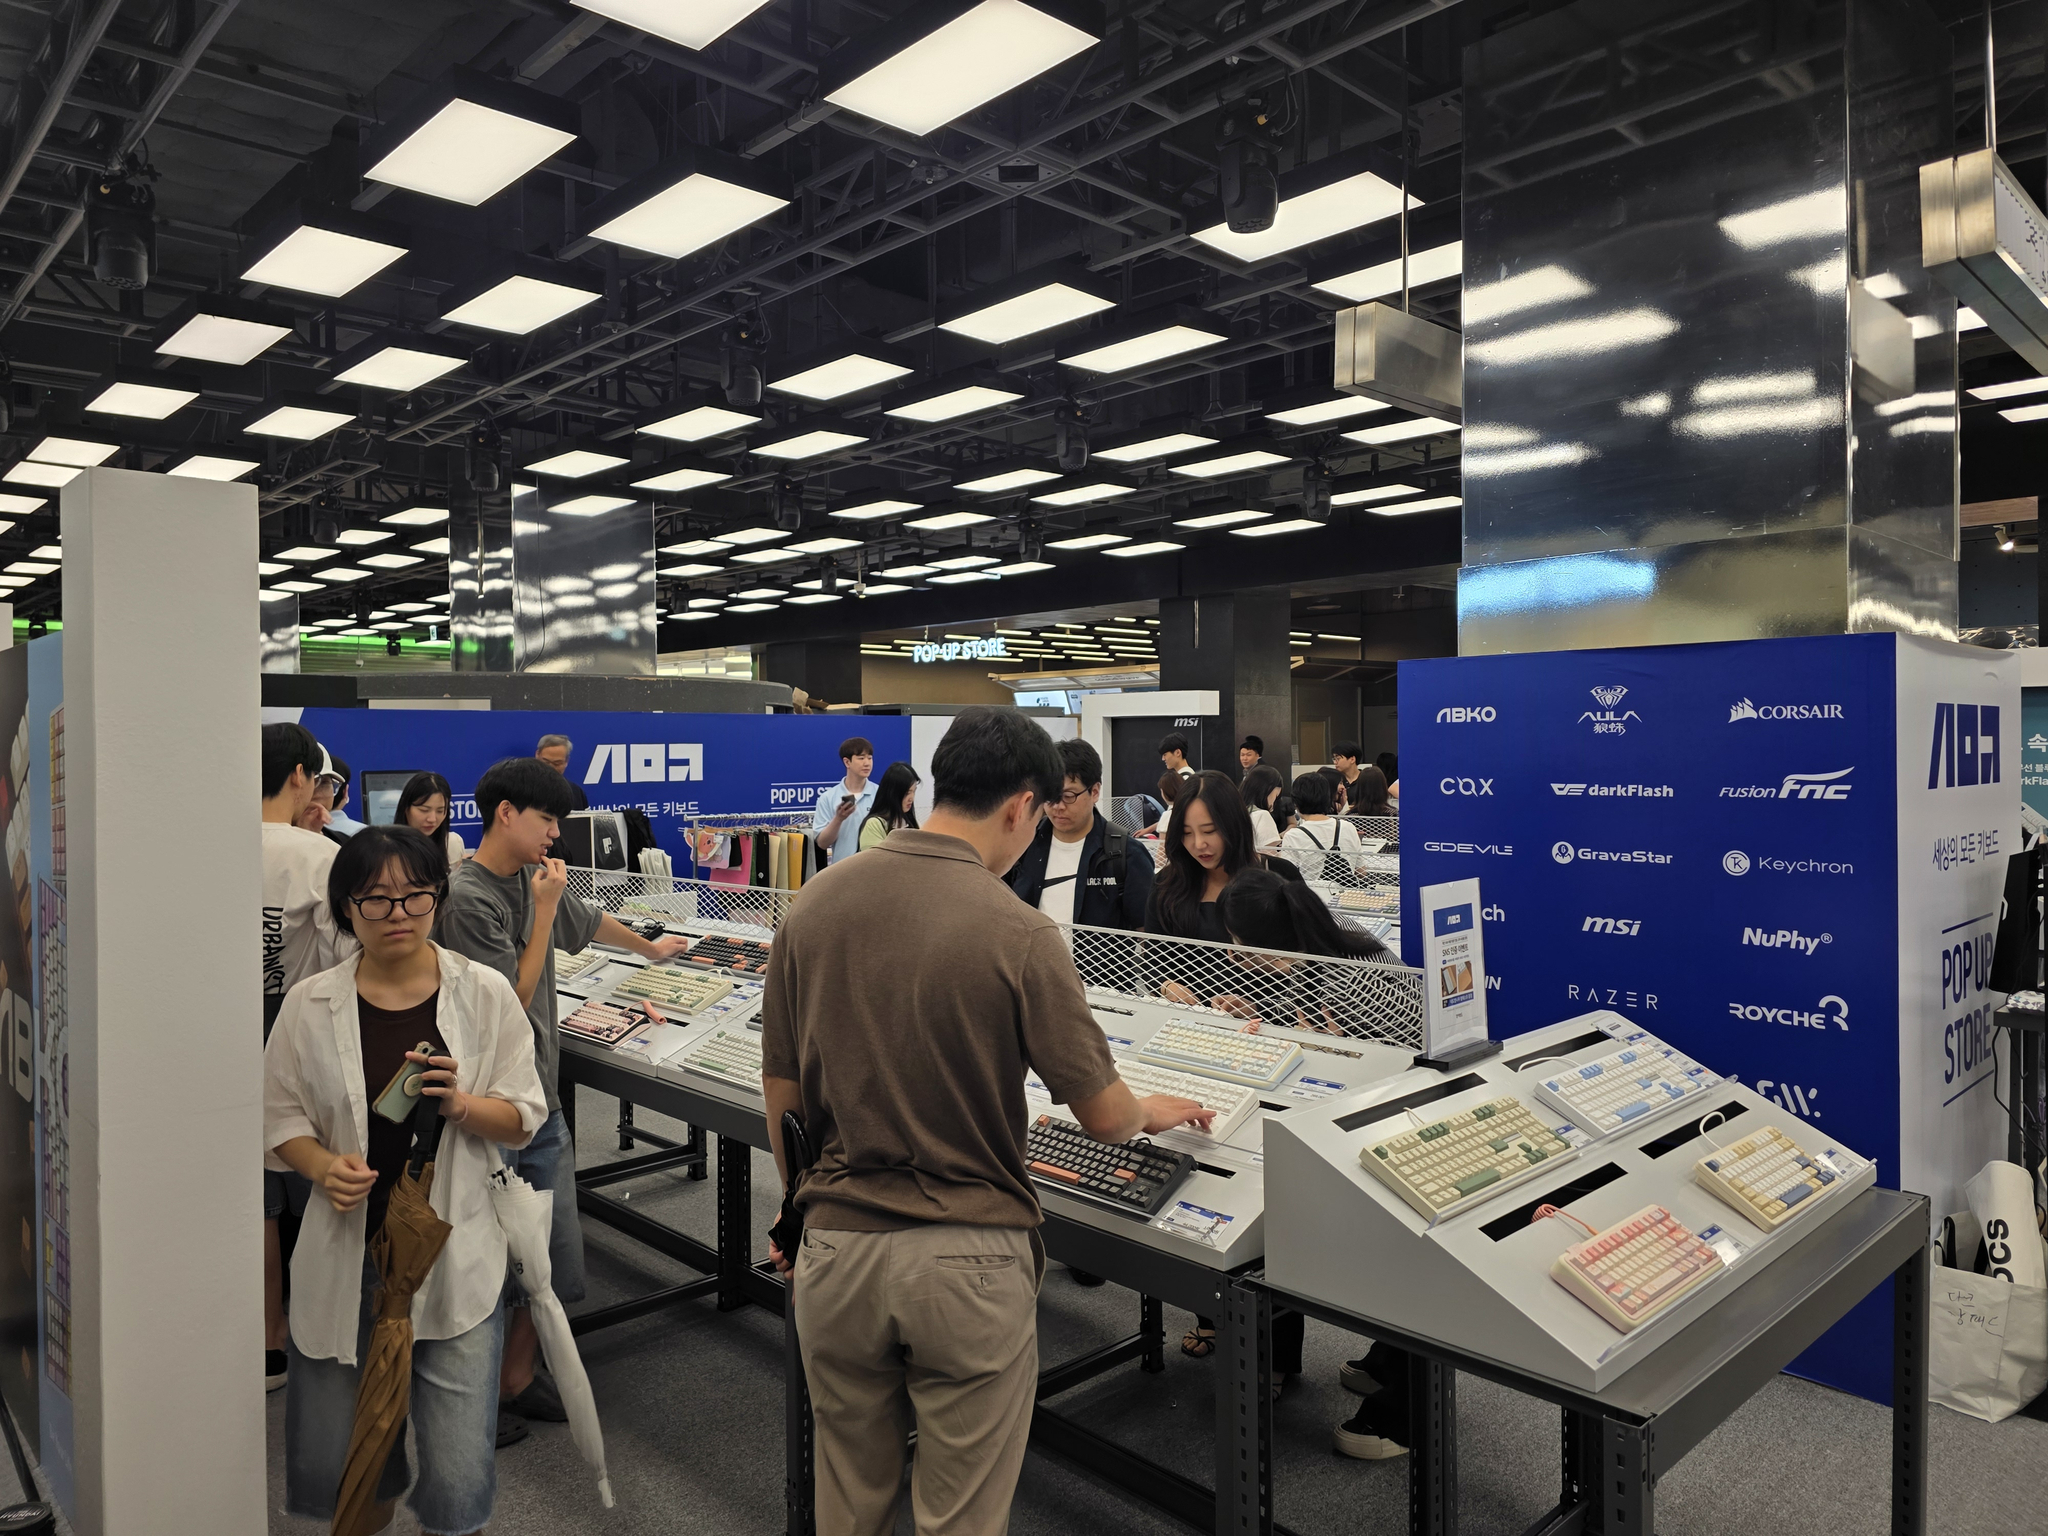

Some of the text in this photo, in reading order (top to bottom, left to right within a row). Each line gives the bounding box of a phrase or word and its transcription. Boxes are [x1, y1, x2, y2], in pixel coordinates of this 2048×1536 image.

[913, 637, 1007, 663] POP-UP STORE
[1436, 706, 1497, 723] ABKO
[1577, 711, 1643, 726] AULA
[1758, 704, 1845, 720] CORSAIR
[1174, 718, 1199, 728] msi
[771, 788, 797, 804] POP
[797, 787, 815, 803] UP
[1588, 783, 1674, 798] darkFlash
[662, 801, 700, 817] 키보드
[1578, 848, 1673, 864] GravaStar
[1933, 829, 2000, 871] 세상의 모든 키보드
[1759, 856, 1854, 874] Keychron
[1582, 916, 1642, 936] msi
[1942, 931, 1994, 1010] POP UP
[1568, 984, 1658, 1010] RAZER
[1944, 1003, 1992, 1085] STORE
